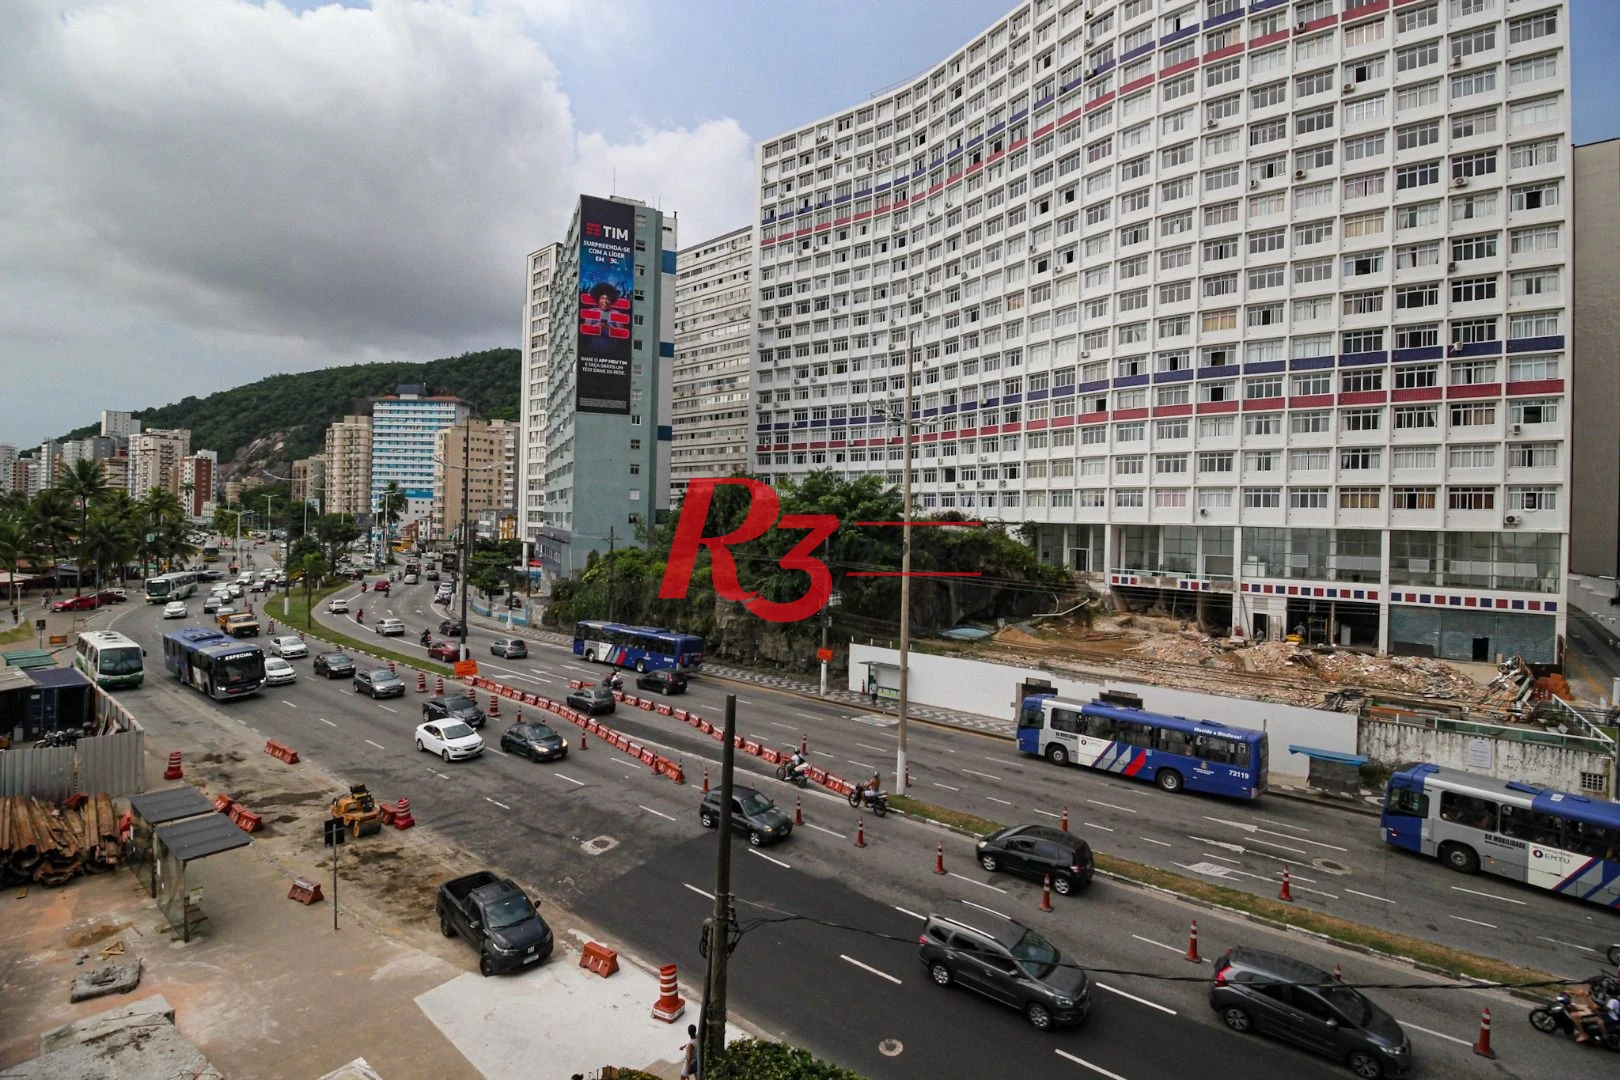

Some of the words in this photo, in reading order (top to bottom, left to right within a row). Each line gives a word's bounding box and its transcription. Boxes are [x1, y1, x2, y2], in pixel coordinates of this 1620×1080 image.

[603, 225, 628, 241] TIM
[583, 240, 630, 253] SURPREENDA-SE
[608, 251, 625, 259] LÍDER
[225, 652, 253, 661] ESPECIAL
[1194, 726, 1212, 735] Movido
[1217, 731, 1242, 740] Biodiesel
[1228, 769, 1249, 779] 72119
[1493, 835, 1526, 850] MOBILIDADE
[1544, 853, 1570, 864] EMTU
